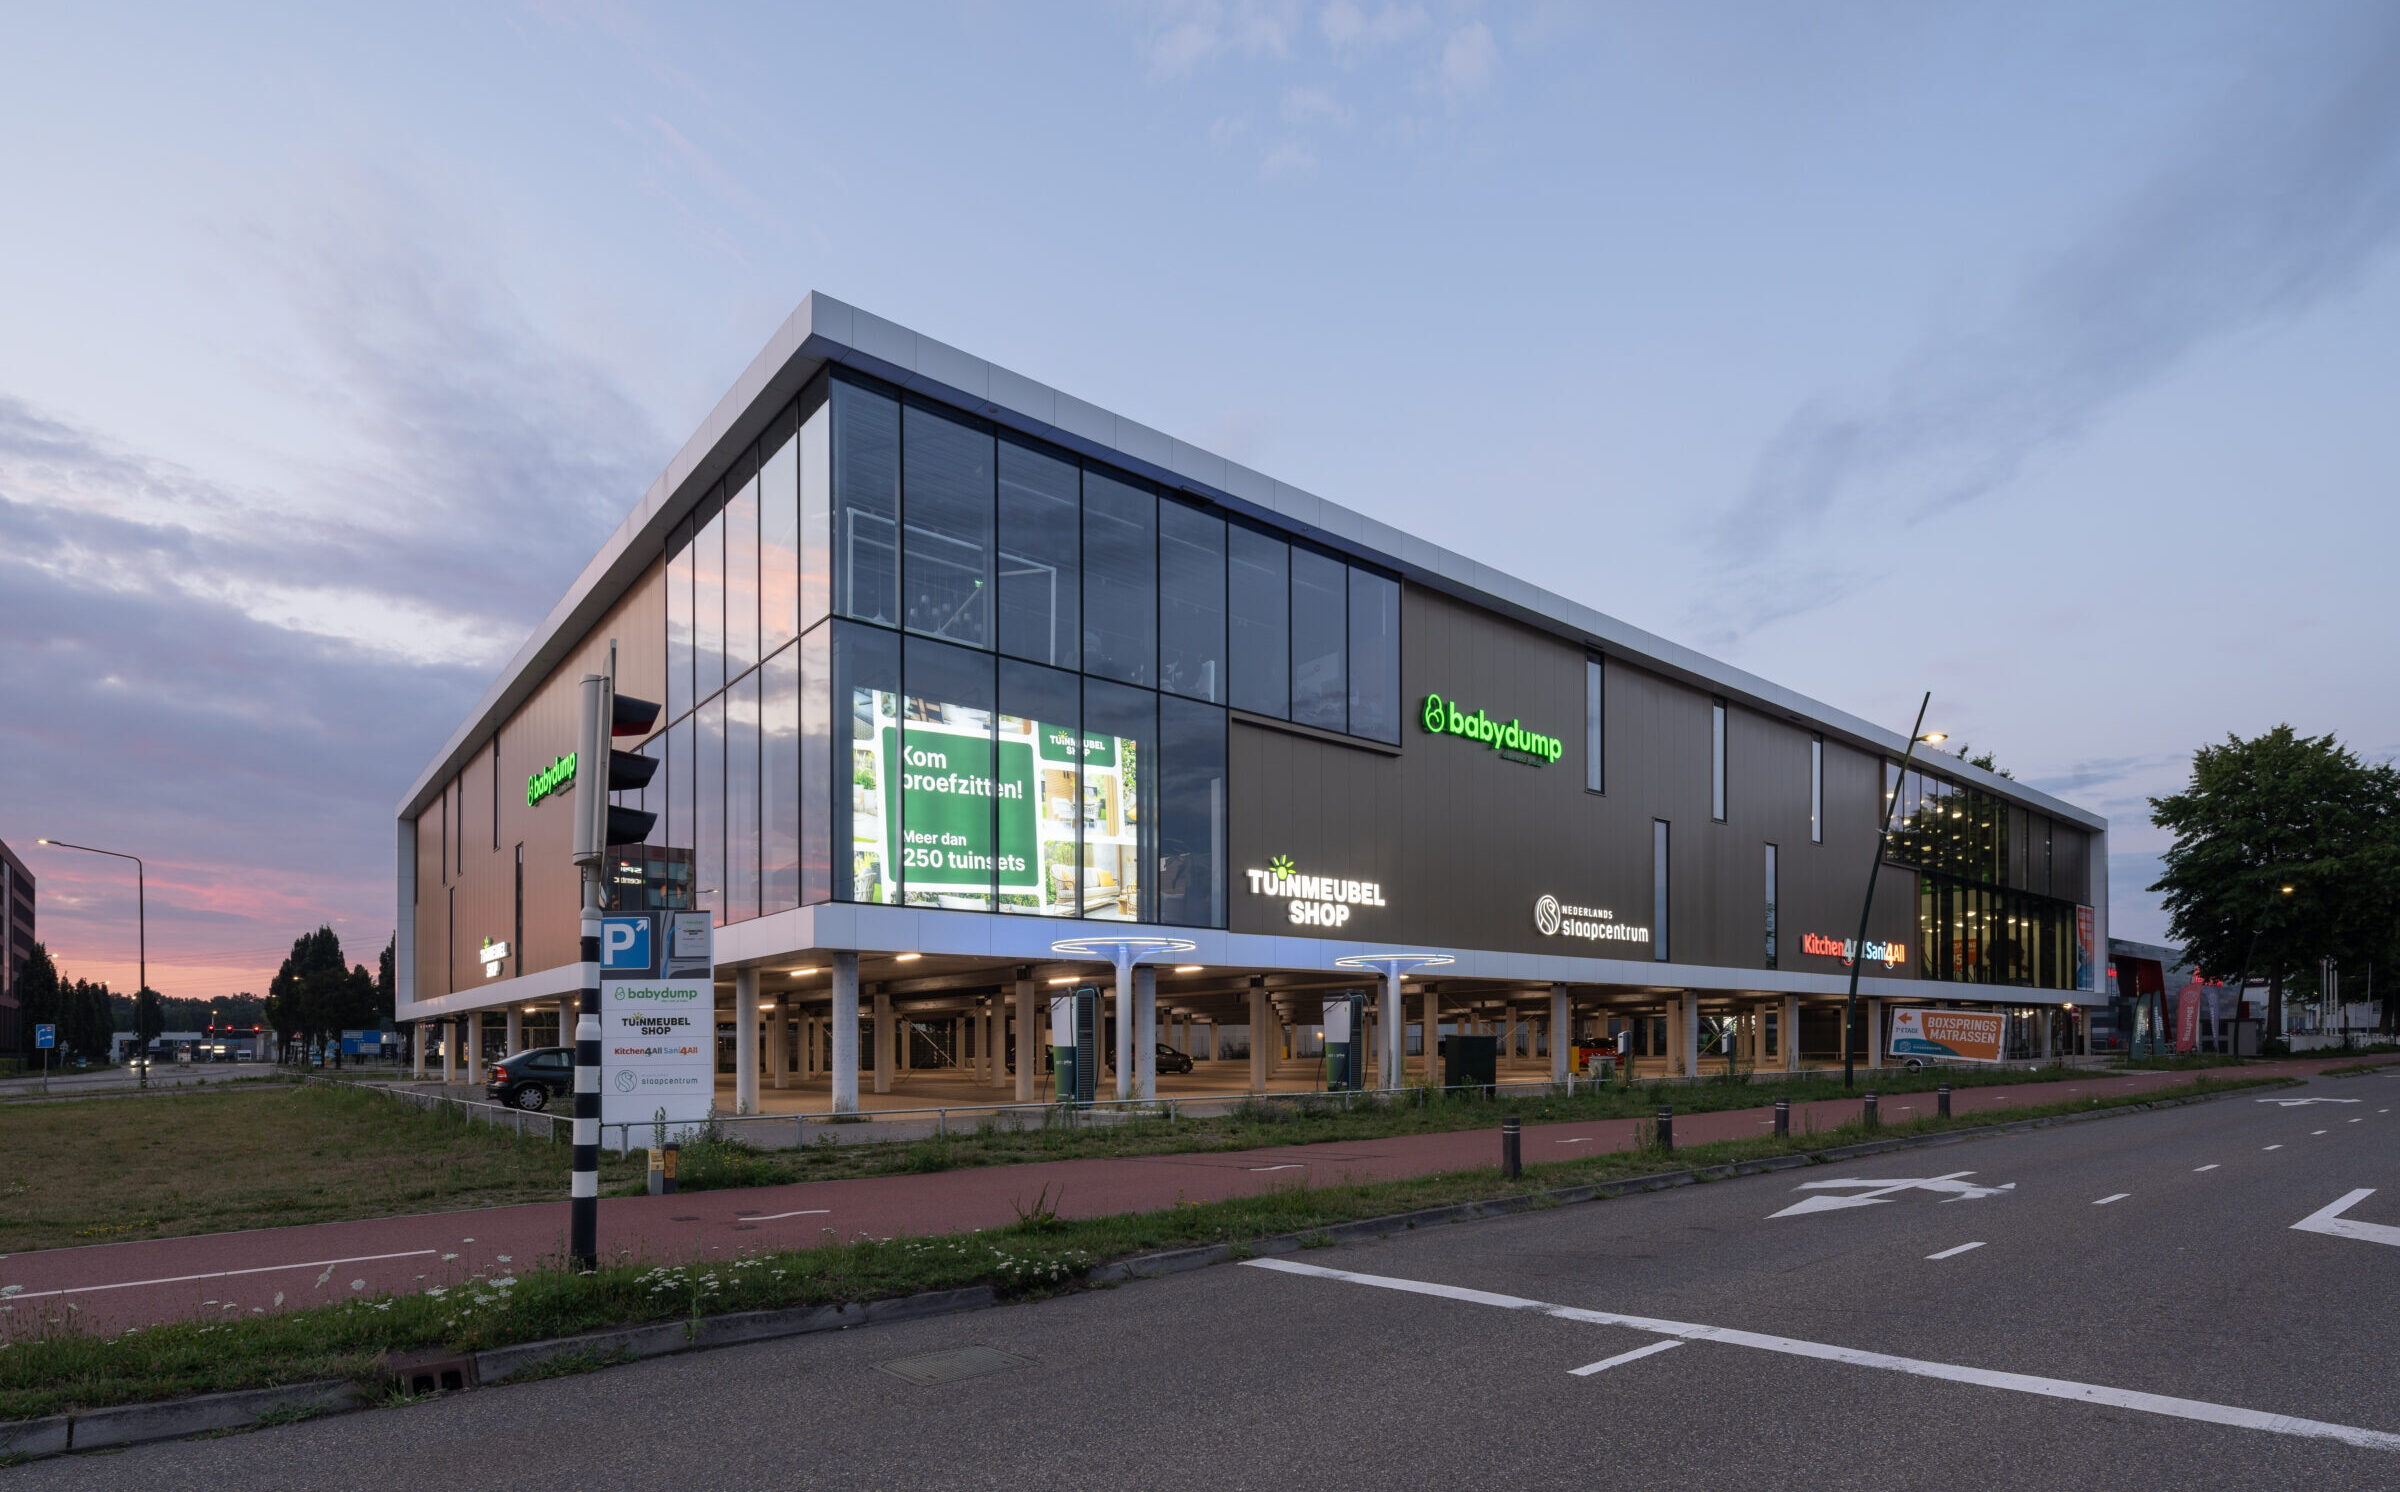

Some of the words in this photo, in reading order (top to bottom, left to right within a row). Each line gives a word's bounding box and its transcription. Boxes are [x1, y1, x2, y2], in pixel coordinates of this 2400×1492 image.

[1449, 701, 1562, 763] babydump
[1049, 735, 1105, 750] TUINMUBEL
[904, 745, 947, 769] Kom
[1066, 746, 1090, 757] SHP
[534, 752, 577, 798] babydump
[904, 830, 938, 844] Meer
[941, 832, 967, 846] dan
[904, 848, 943, 868] 250
[948, 851, 1025, 871] tuinsets
[1247, 869, 1386, 906] TUINMEUBEL
[1289, 900, 1350, 927] SHOP
[1562, 905, 1613, 919] NEDERLANDS
[1563, 918, 1649, 942] slaapcentrum
[604, 923, 635, 965] P
[1866, 941, 1905, 966] Sani4All
[628, 987, 697, 1001] babydump
[622, 1017, 691, 1027] TUINMEUBEL
[1928, 1016, 1998, 1032] BOXSPRINGS
[641, 1026, 672, 1035] SHOP
[1929, 1028, 1996, 1044] MATRASSEN
[614, 1047, 662, 1057] Kitchen4All
[663, 1046, 698, 1055] Sani4All
[641, 1077, 698, 1085] slaapcentrum
